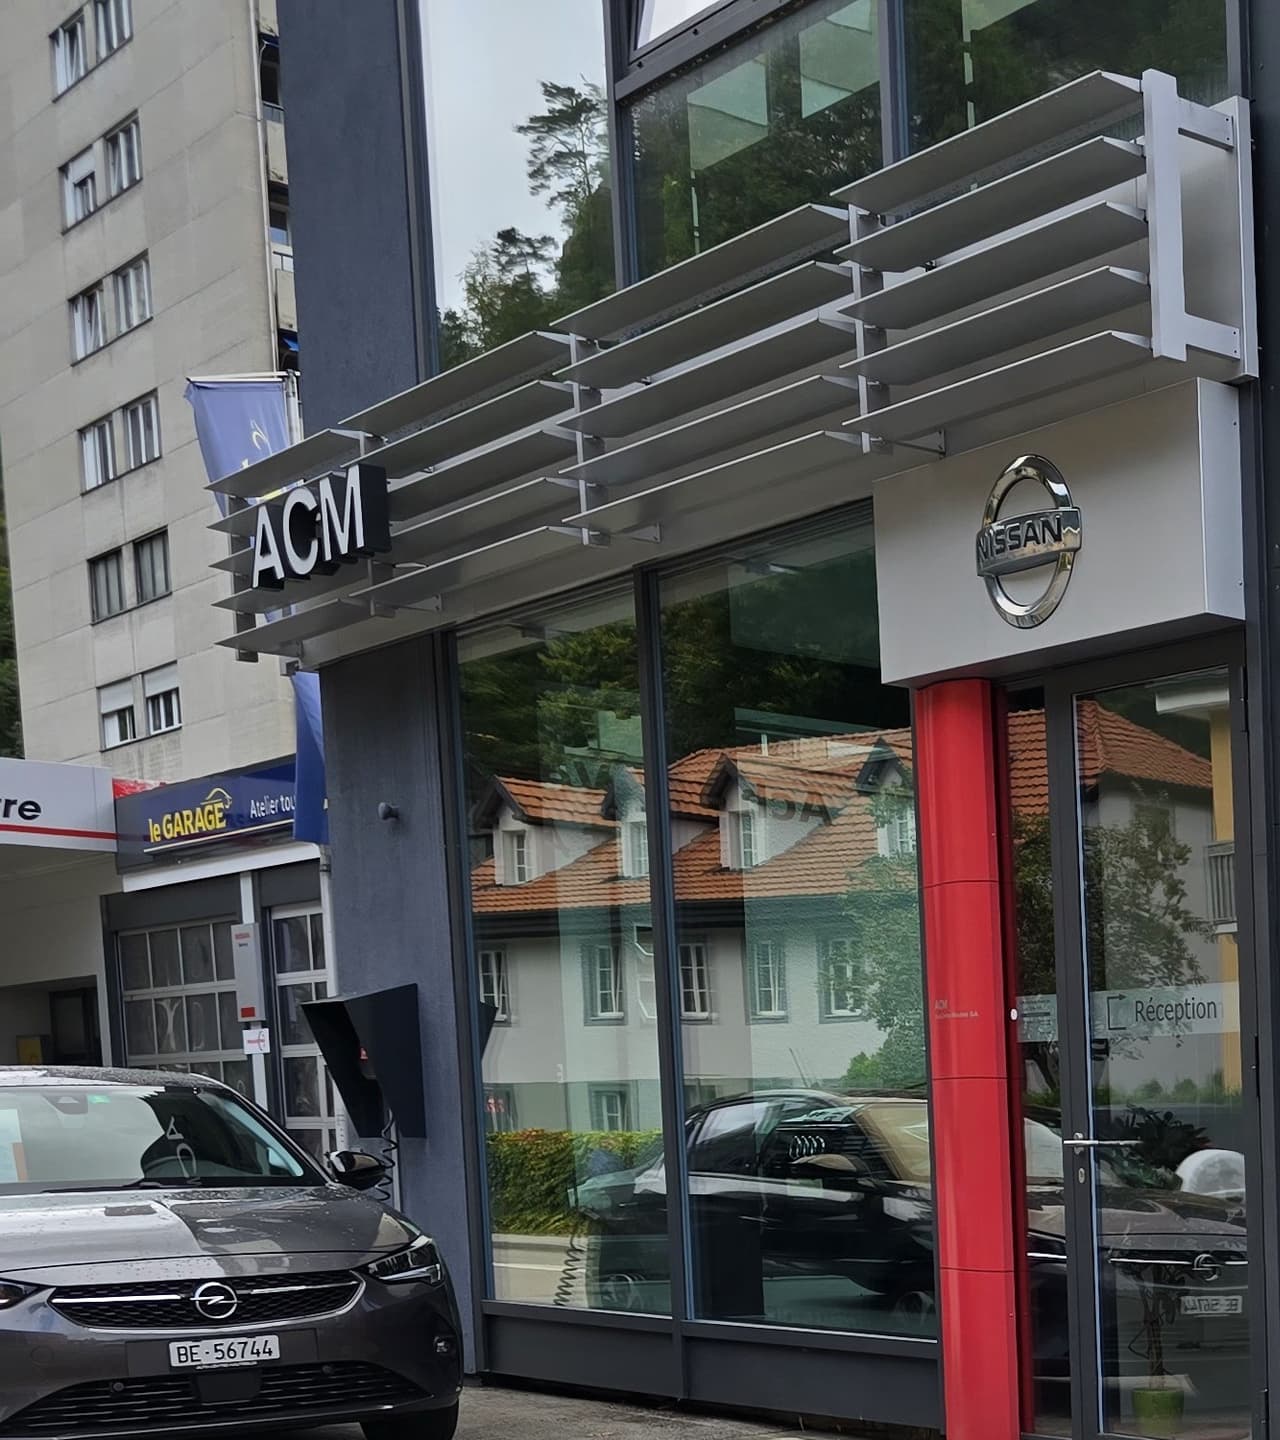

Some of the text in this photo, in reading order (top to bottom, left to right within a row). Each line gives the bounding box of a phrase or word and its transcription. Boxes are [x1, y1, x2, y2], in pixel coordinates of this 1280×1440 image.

[252, 465, 365, 588] ACM
[977, 514, 1063, 562] NISSAN
[0, 798, 42, 821] re
[149, 802, 227, 843] le GARAGE
[250, 794, 297, 819] Atelier tou
[1135, 996, 1217, 1026] Réception
